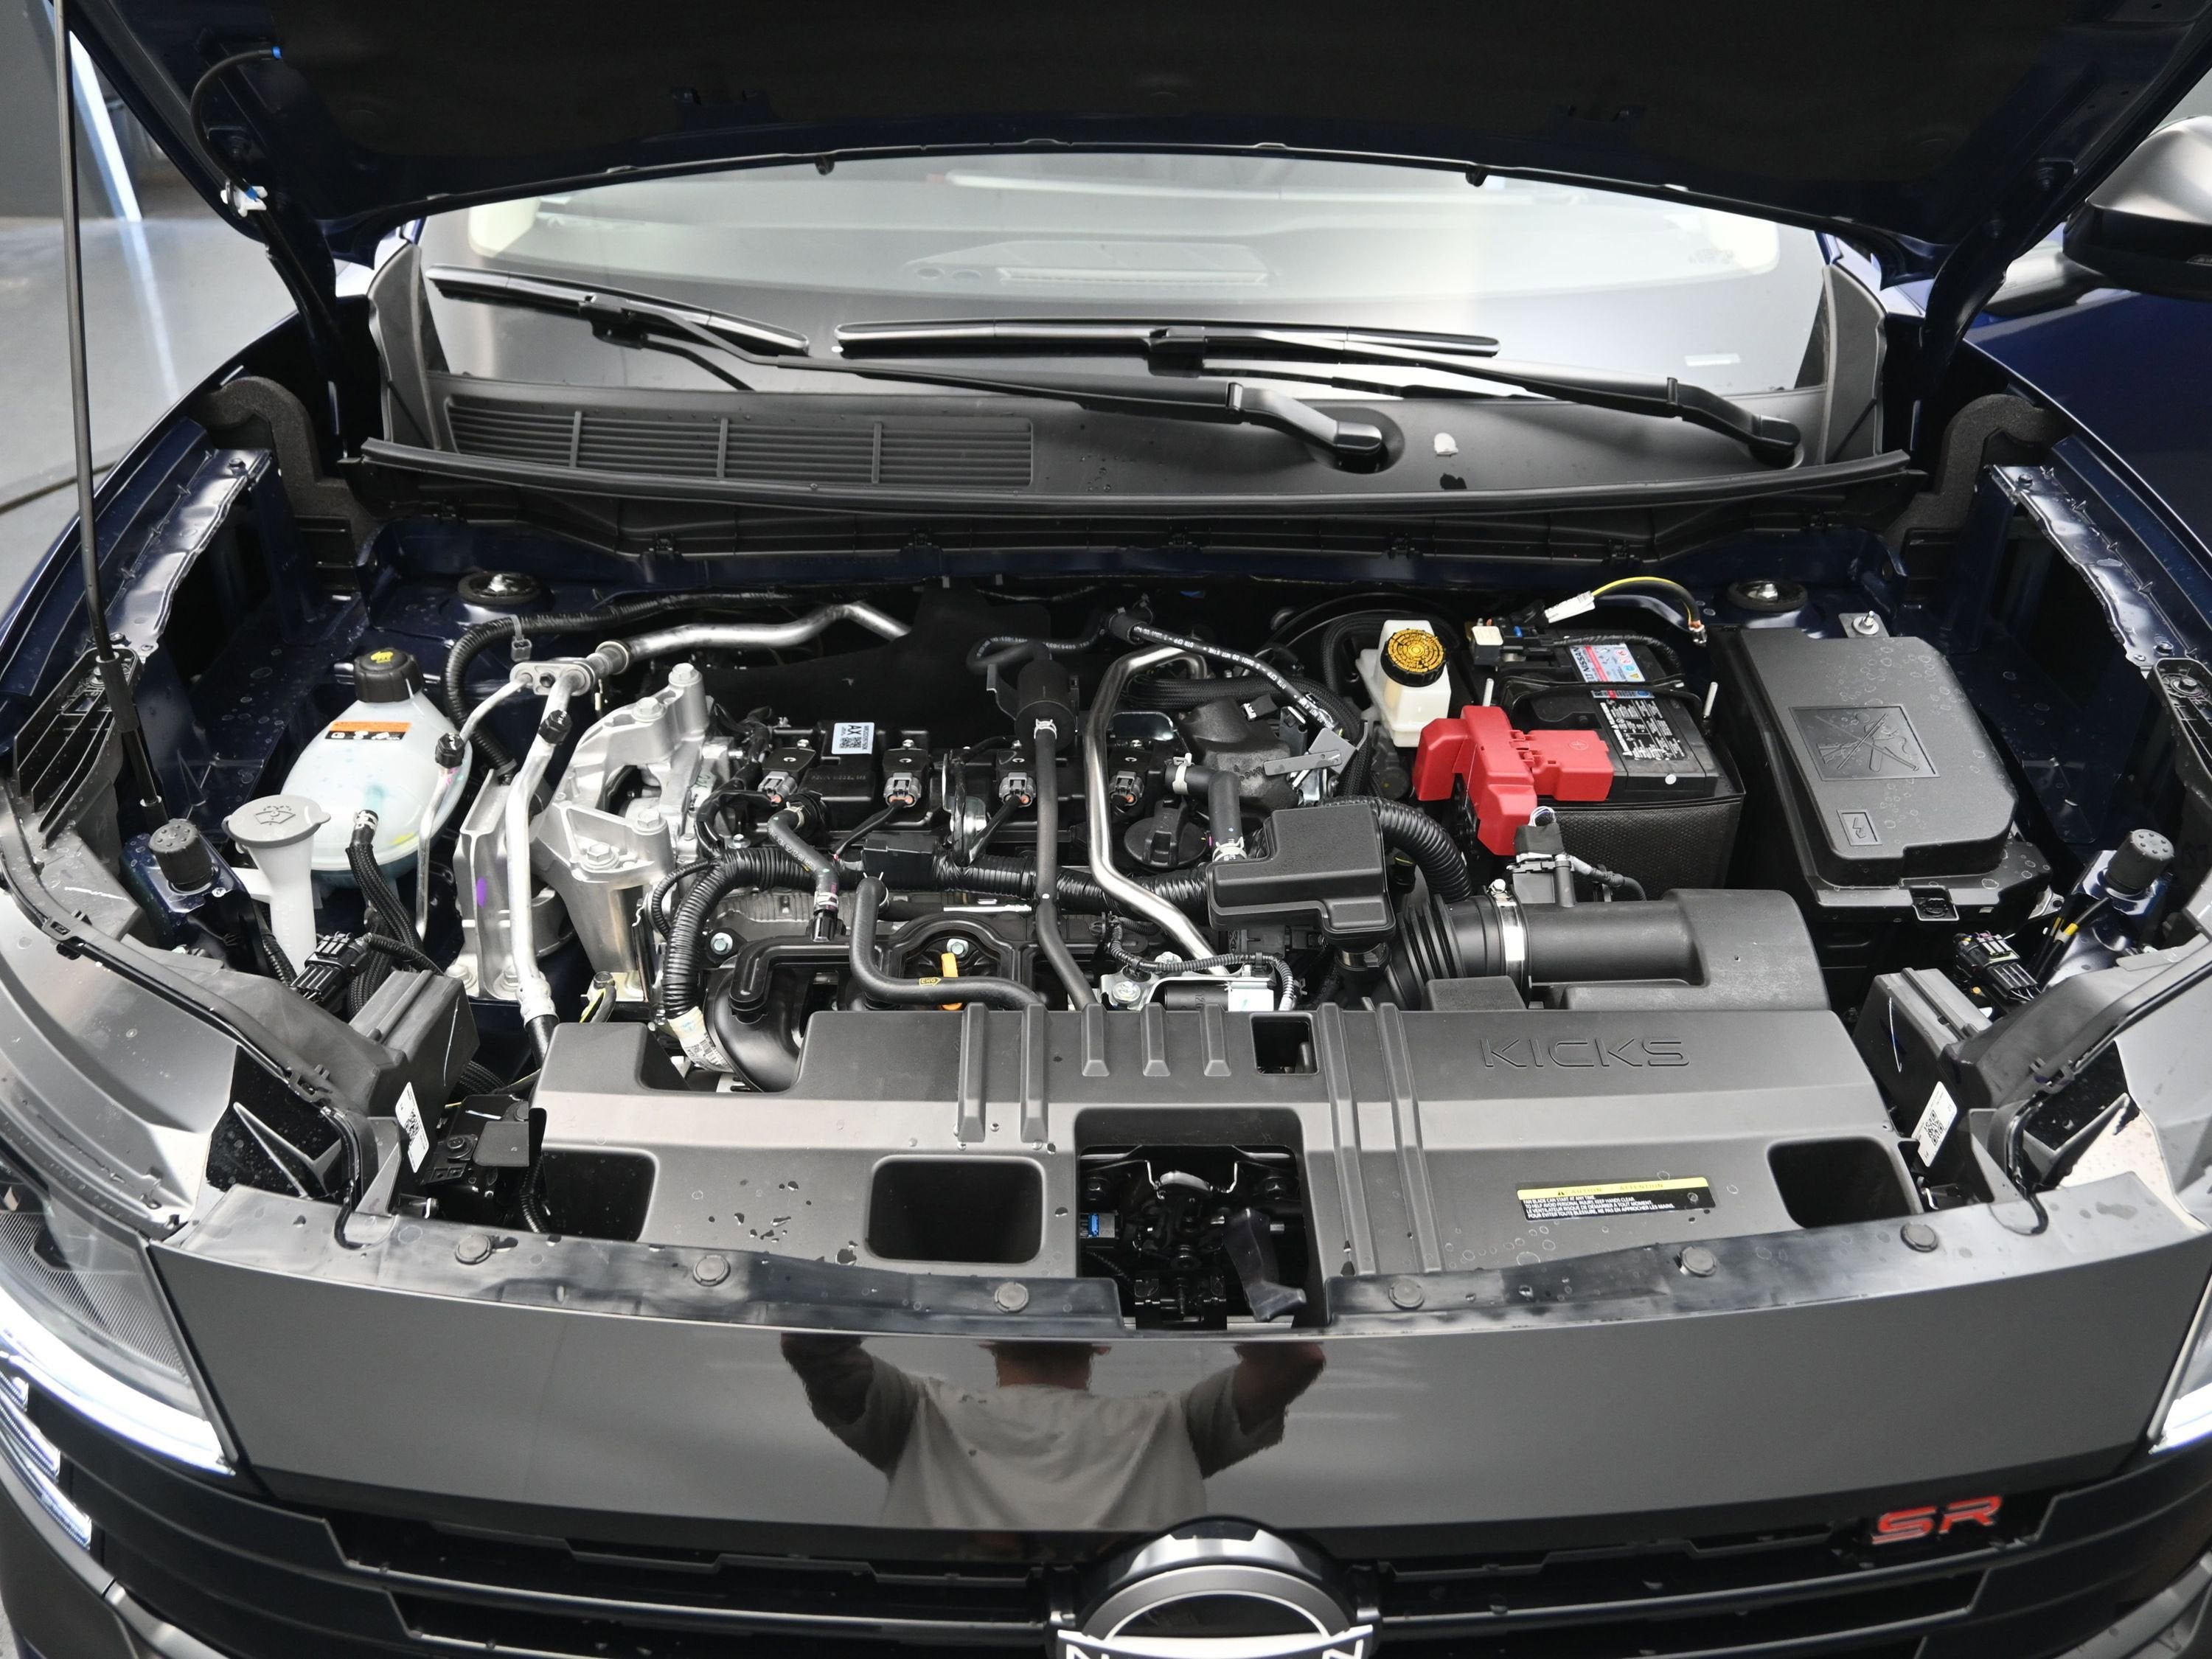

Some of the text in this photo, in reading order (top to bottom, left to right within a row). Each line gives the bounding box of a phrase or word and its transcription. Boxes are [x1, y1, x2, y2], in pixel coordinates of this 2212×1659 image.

[1571, 646, 1590, 672] NISSAN
[1480, 1038, 1689, 1068] KICKS
[1871, 1495, 2003, 1545] SR
